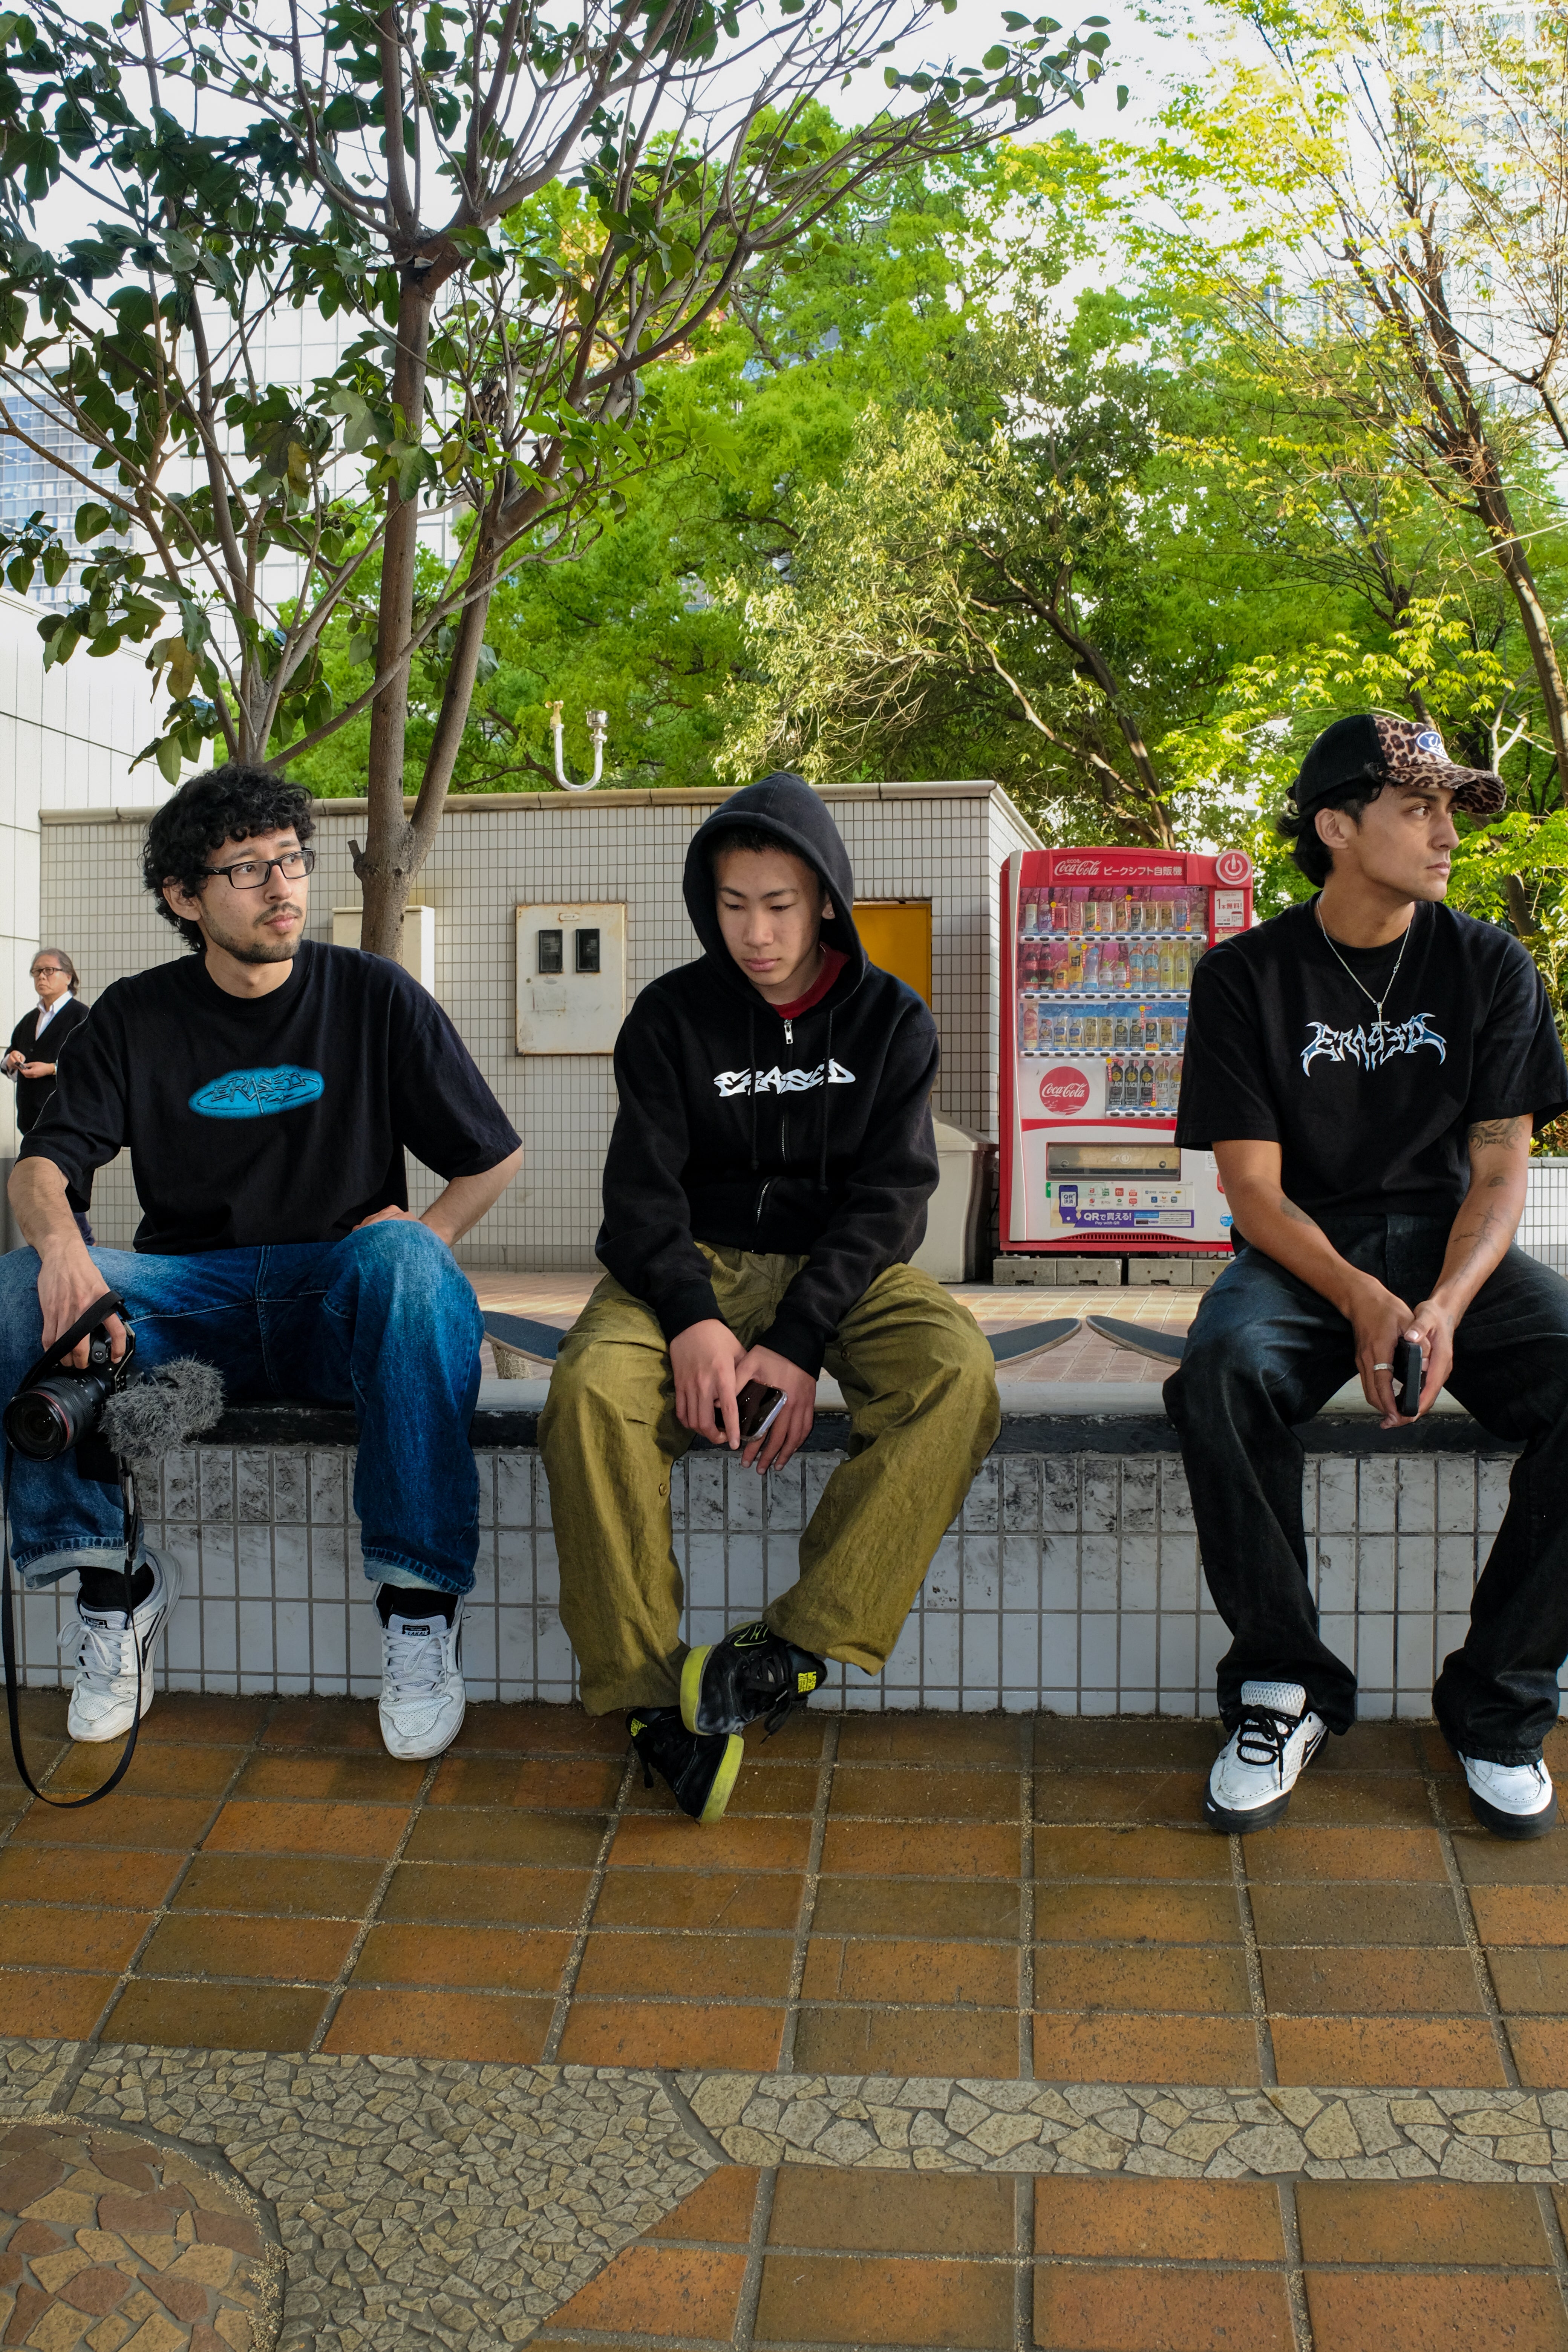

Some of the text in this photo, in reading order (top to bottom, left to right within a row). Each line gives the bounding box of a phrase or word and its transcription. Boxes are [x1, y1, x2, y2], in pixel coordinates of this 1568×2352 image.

[1054, 861, 1102, 876] Coca-Cola
[1104, 867, 1182, 876] ピークシフト自販機
[1300, 1013, 1447, 1077] ERASED
[714, 1058, 856, 1097] ERASED
[211, 1072, 306, 1114] ERASED
[1042, 1083, 1087, 1098] Coca-Cola
[1084, 1213, 1132, 1221] QRで買える!
